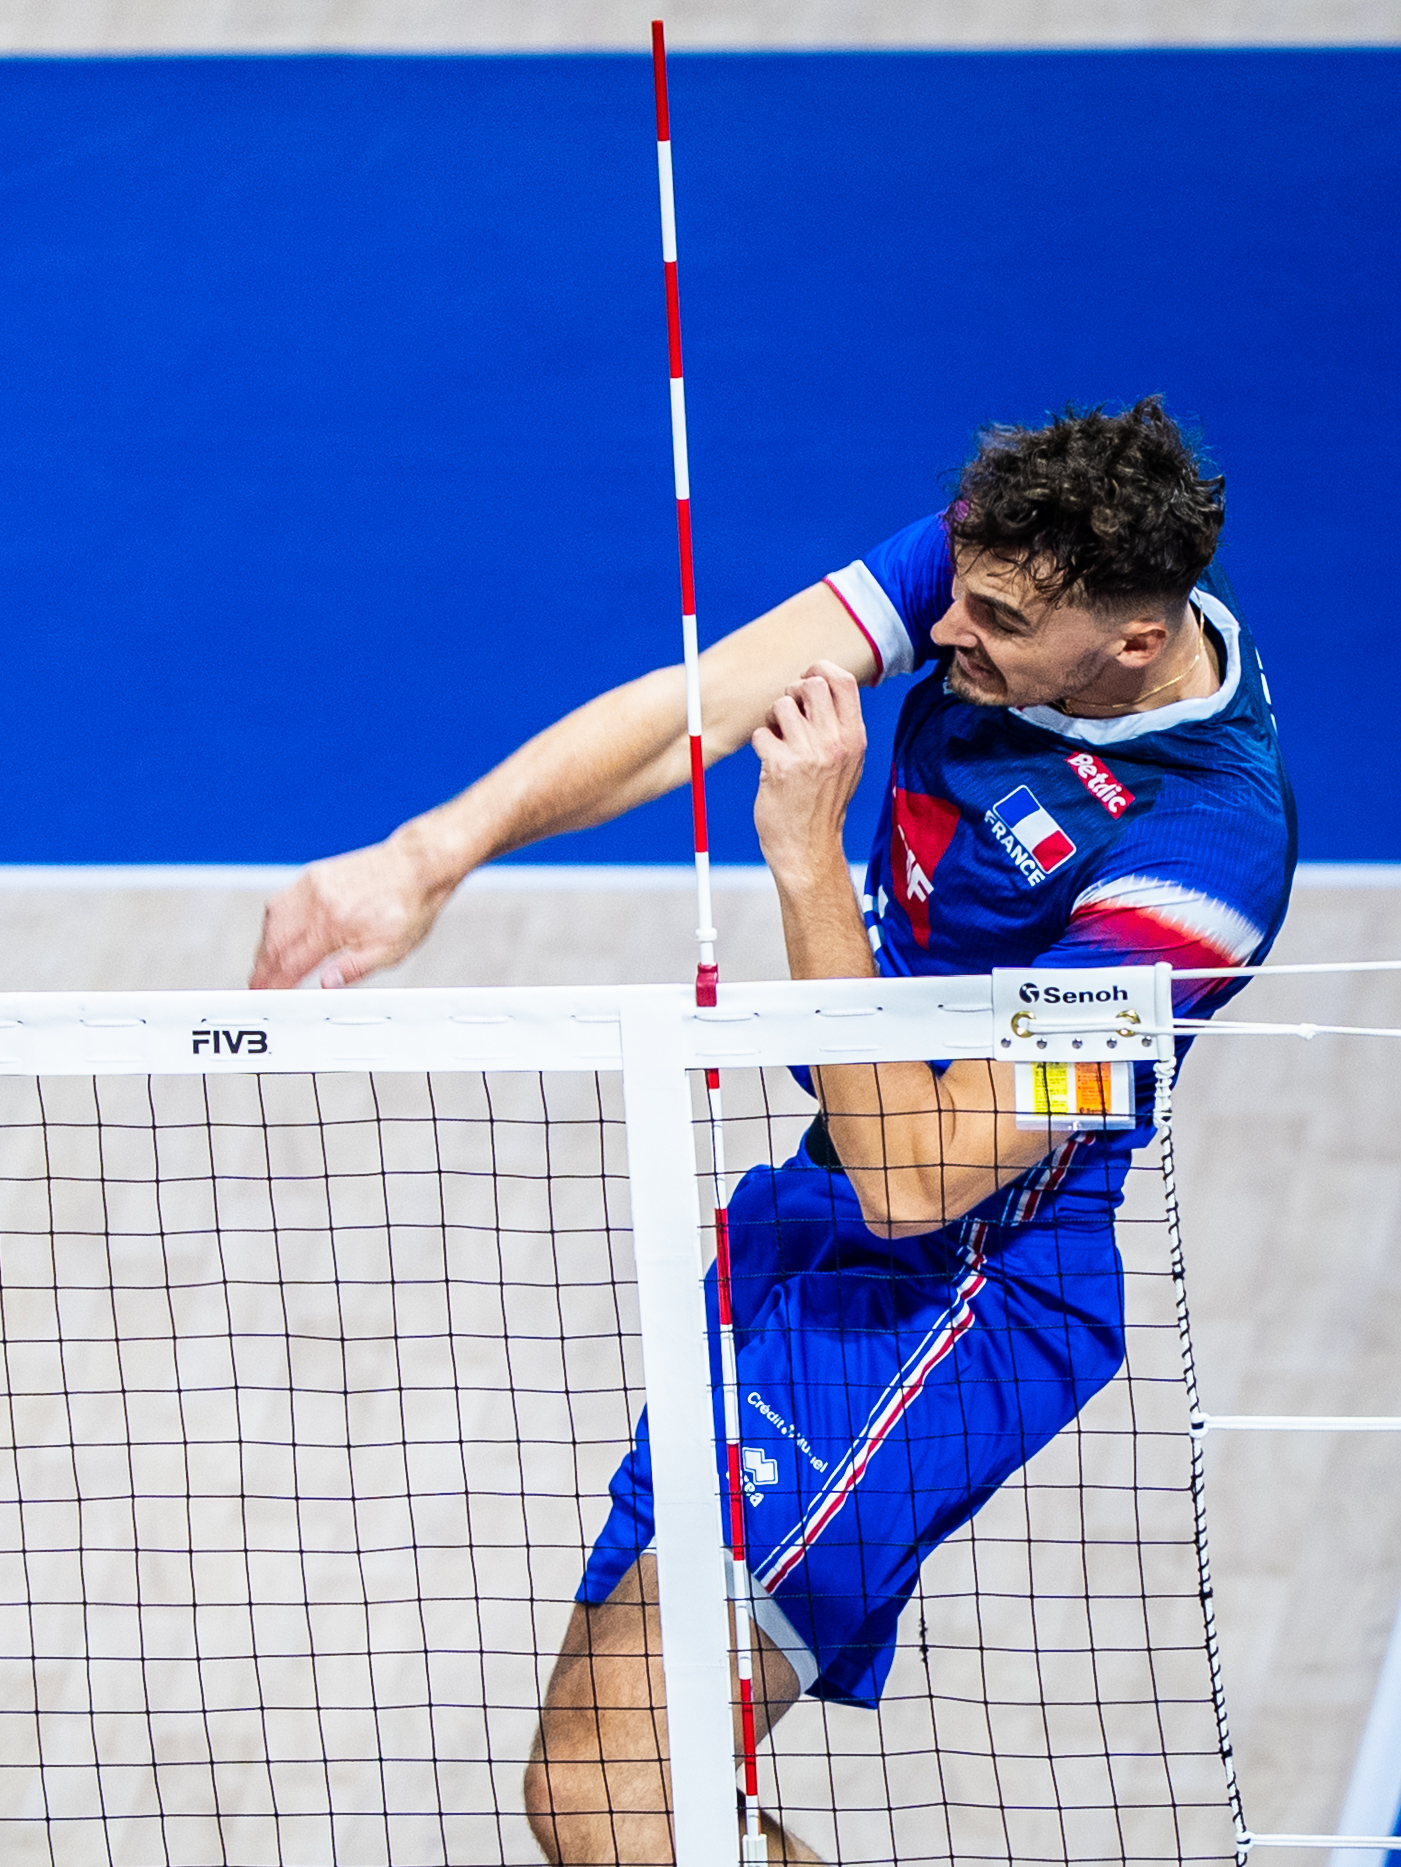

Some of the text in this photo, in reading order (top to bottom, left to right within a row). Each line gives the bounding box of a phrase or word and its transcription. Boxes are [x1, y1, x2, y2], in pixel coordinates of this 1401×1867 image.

[984, 809, 1046, 887] FRANCE
[1043, 985, 1129, 1004] Senoh
[192, 1029, 268, 1054] FIVB
[747, 1391, 786, 1429] Crédit
